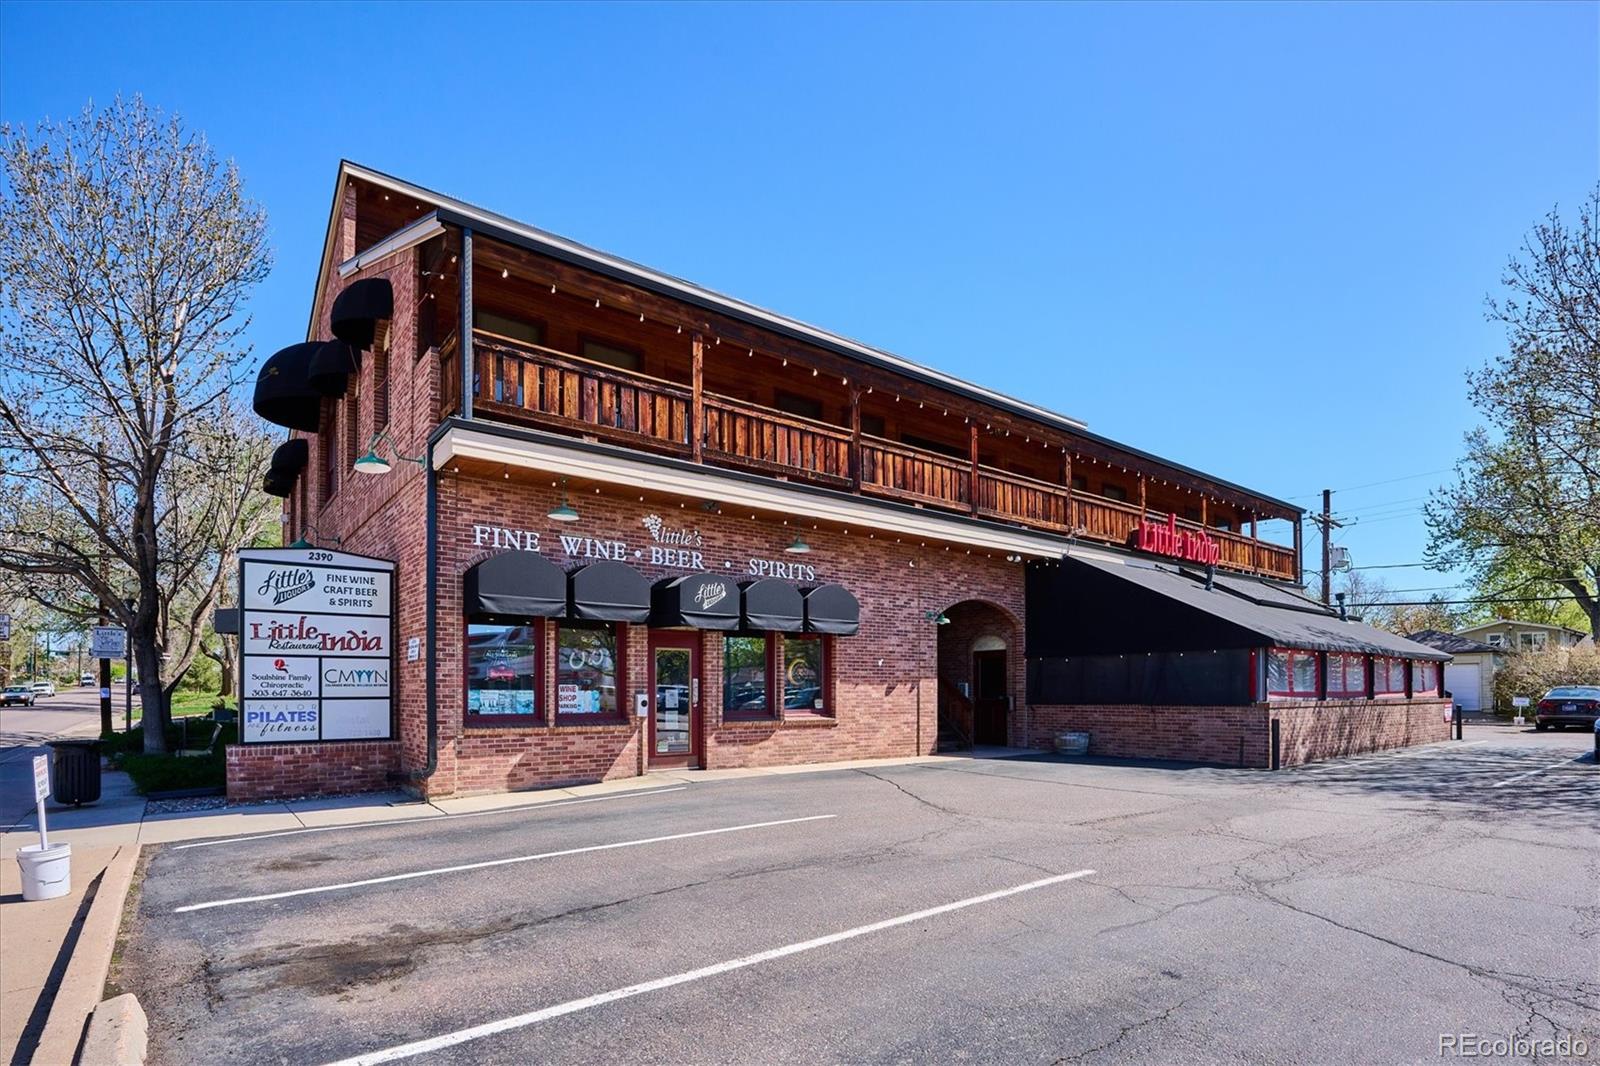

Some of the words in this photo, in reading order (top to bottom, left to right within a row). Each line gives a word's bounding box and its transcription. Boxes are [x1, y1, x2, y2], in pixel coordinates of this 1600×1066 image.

[658, 526, 702, 547] little's
[1139, 513, 1183, 558] Little
[1184, 528, 1219, 564] India
[308, 552, 333, 562] 2390
[473, 525, 541, 552] FINE
[560, 535, 628, 561] WINE
[650, 546, 705, 570] BEER
[748, 558, 816, 581] SPIRITS
[258, 568, 314, 597] Little's
[326, 574, 348, 584] FINE
[348, 575, 376, 586] WINE
[324, 586, 354, 596] CRAFT
[356, 586, 378, 597] BEER
[330, 598, 336, 606] &
[338, 598, 373, 608] SPIRITS
[250, 616, 320, 641] Little
[318, 630, 384, 651] India
[268, 640, 322, 650] Restaurant
[288, 674, 312, 682] Family
[247, 711, 317, 722] PILATES
[260, 722, 316, 737] fitness
